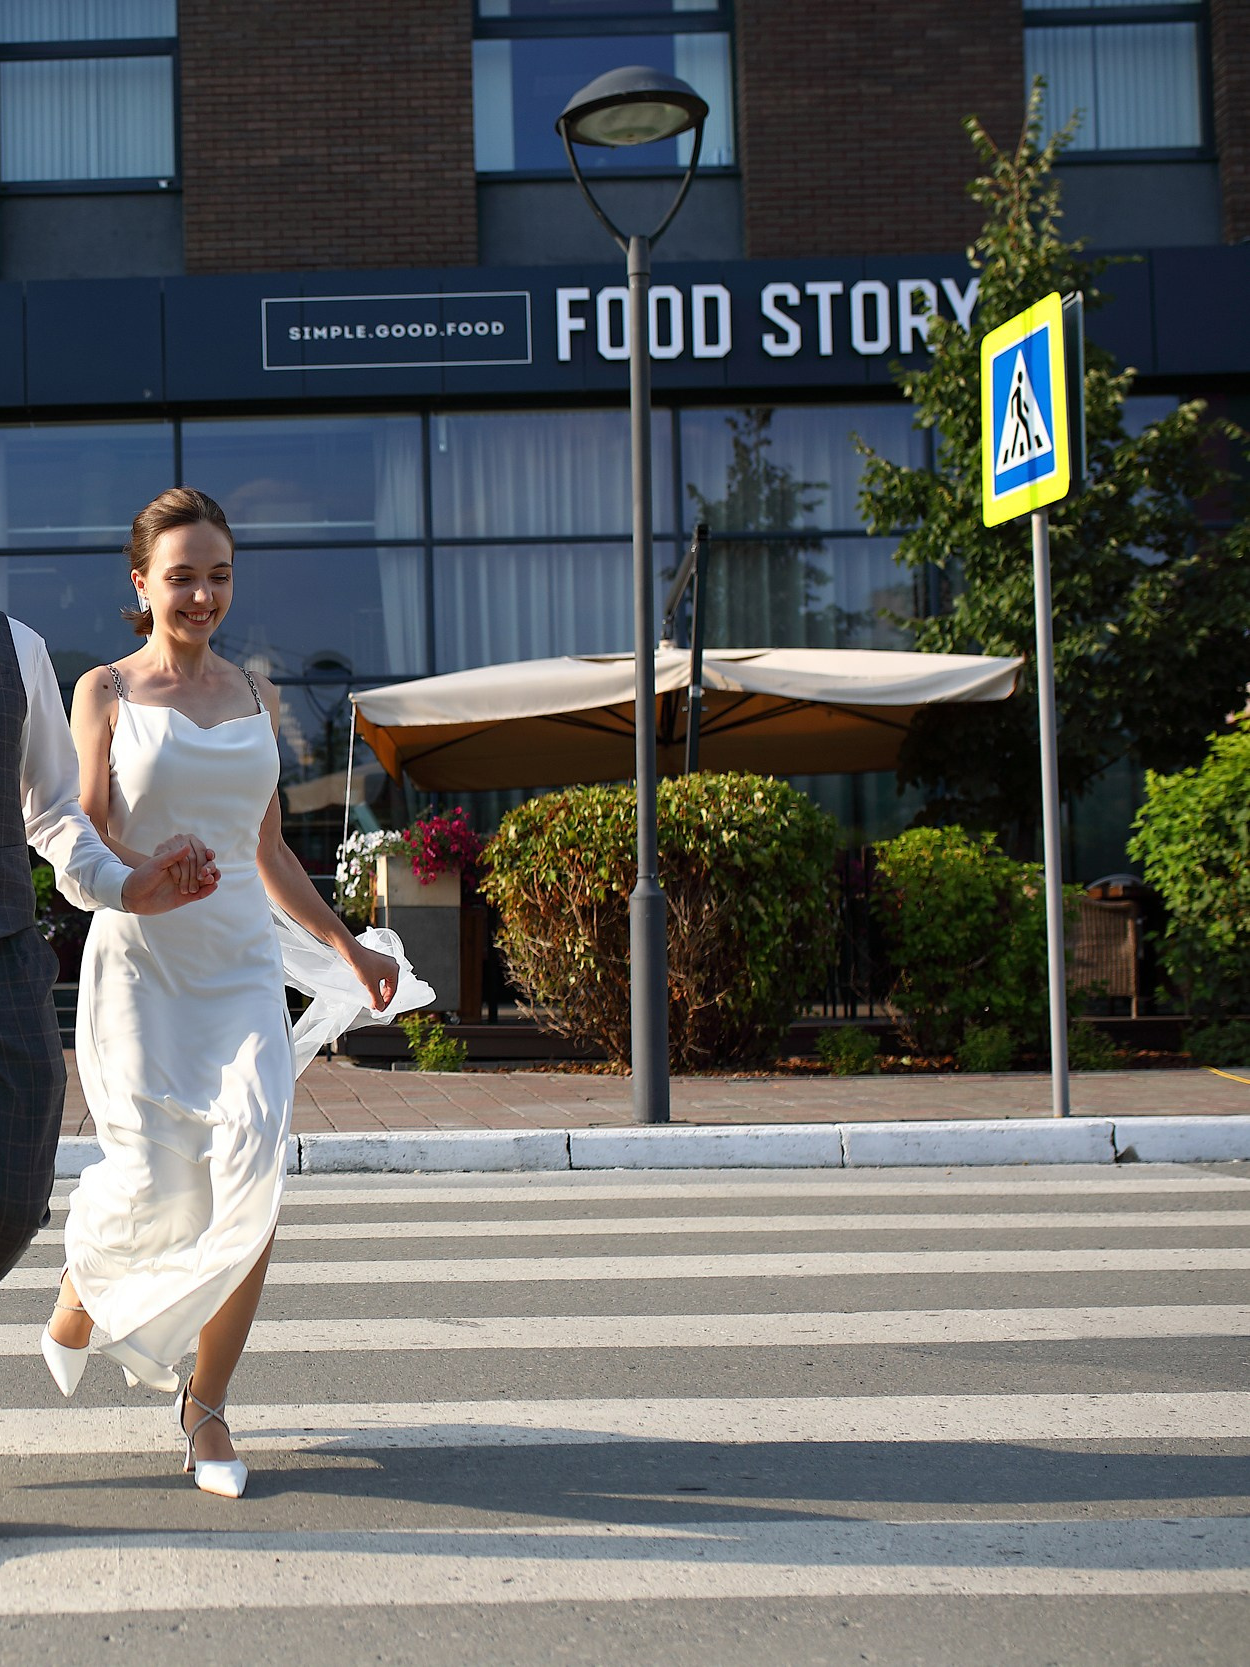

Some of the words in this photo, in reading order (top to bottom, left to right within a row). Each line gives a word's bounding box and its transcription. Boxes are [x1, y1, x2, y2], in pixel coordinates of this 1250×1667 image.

[288, 321, 505, 341] SIMPLE.GOOD.FOOD
[556, 283, 732, 362] FOOD
[760, 277, 981, 357] STORY
